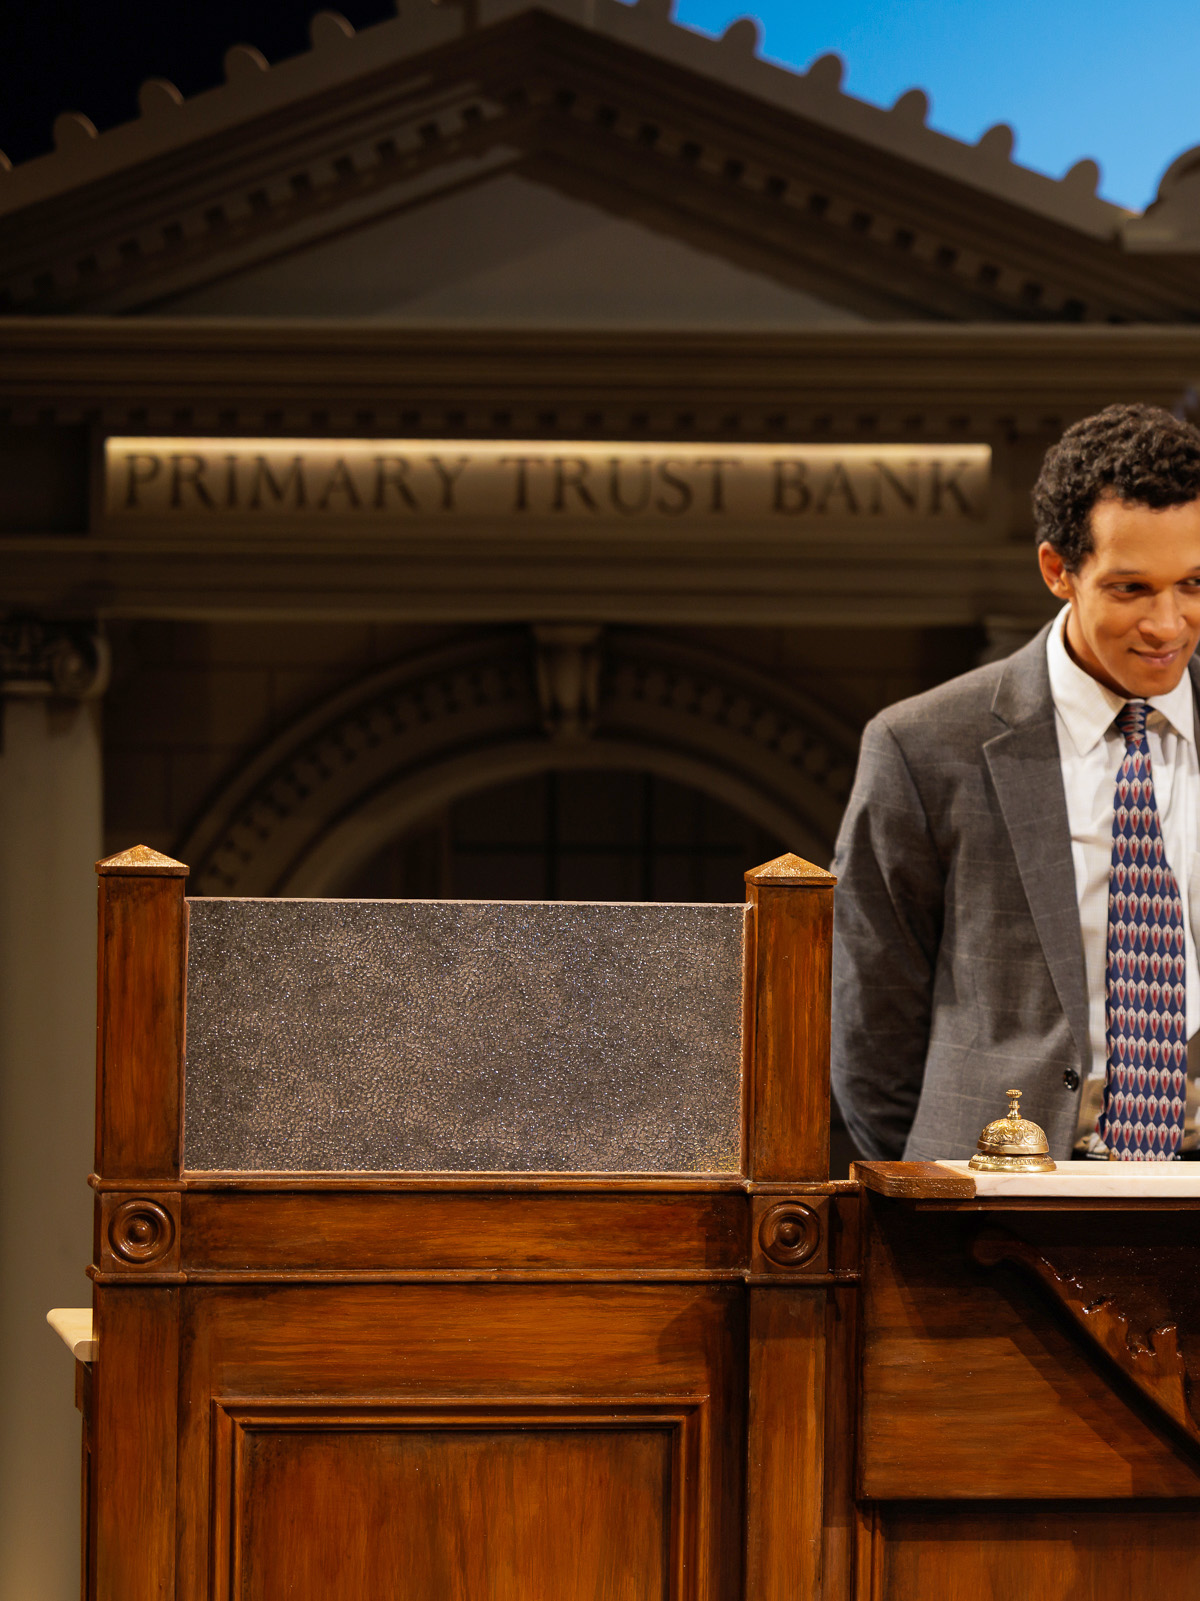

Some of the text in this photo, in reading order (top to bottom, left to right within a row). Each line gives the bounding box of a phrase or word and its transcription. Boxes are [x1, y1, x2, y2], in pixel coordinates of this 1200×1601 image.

[124, 453, 987, 521] PRIMARY TRUST BANK
